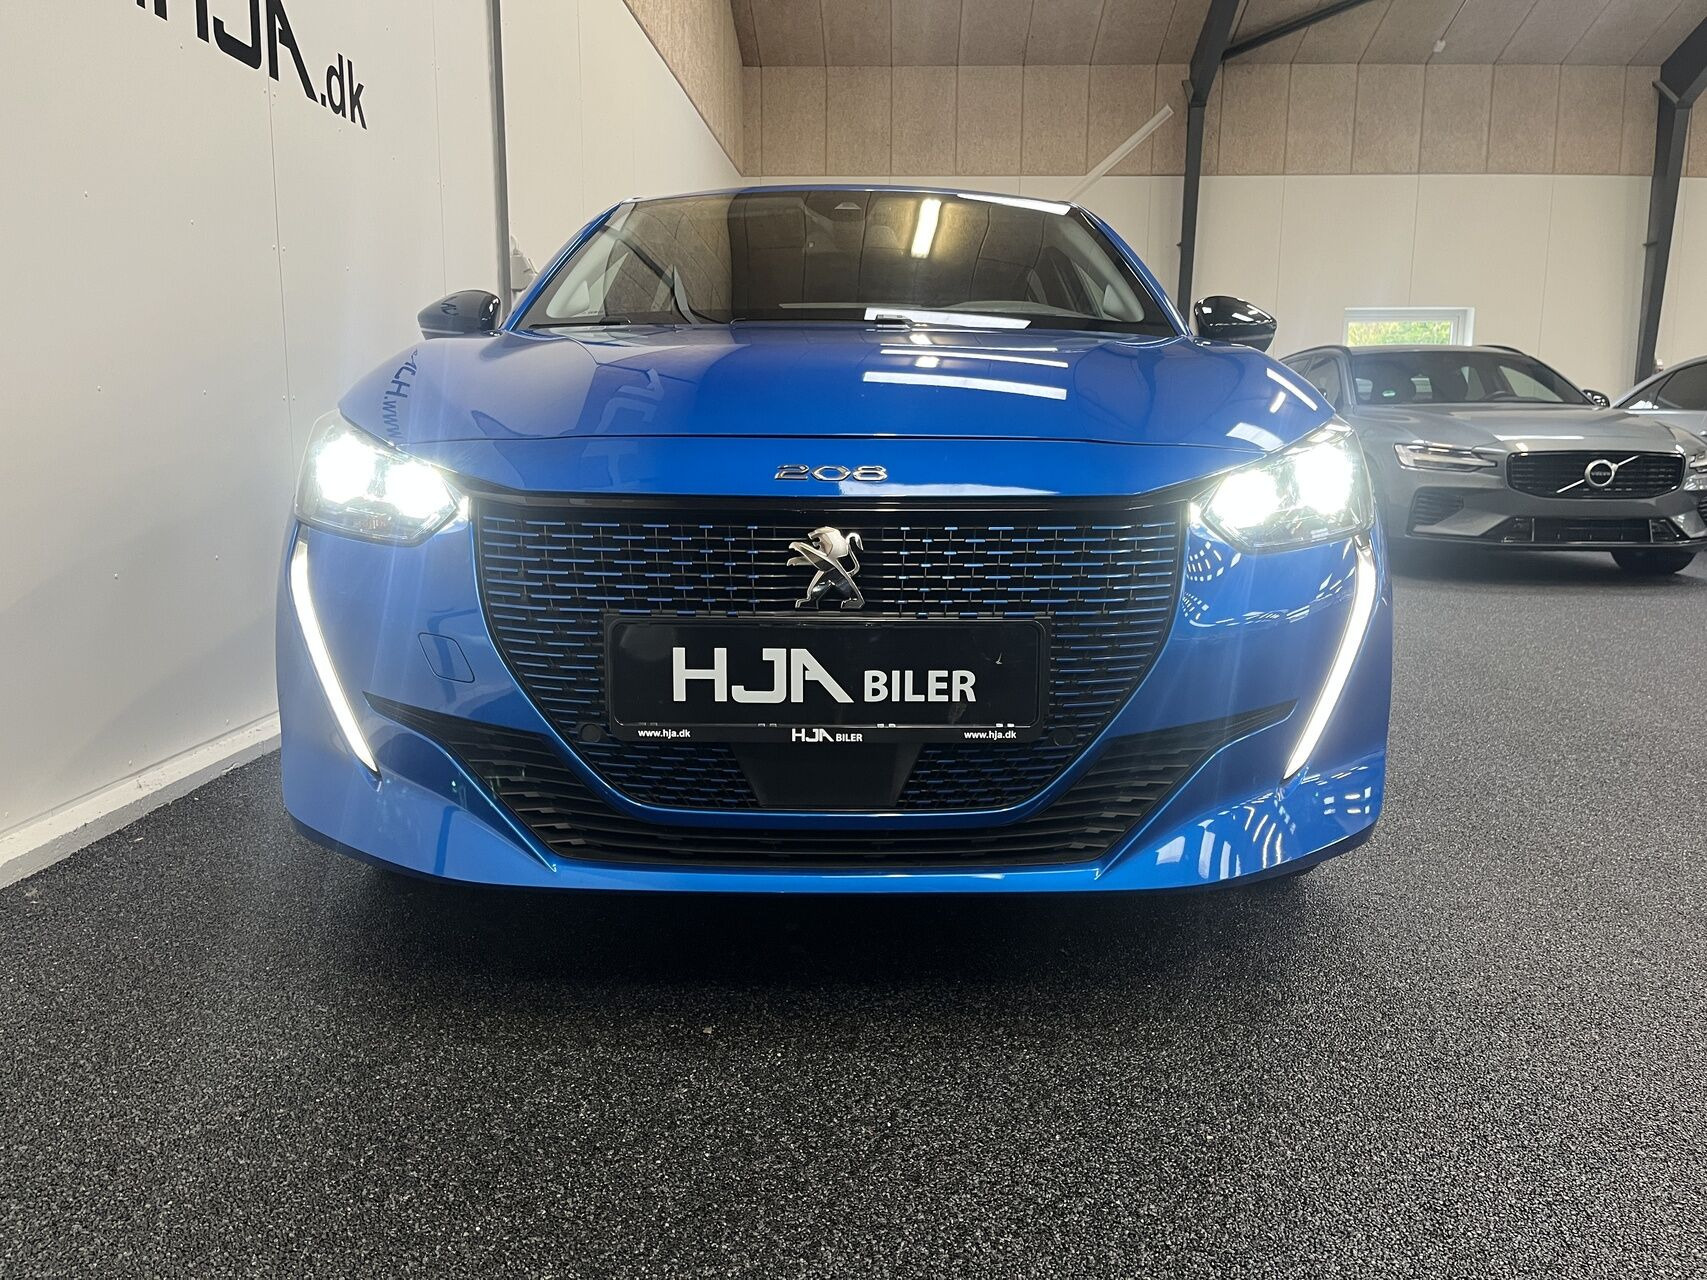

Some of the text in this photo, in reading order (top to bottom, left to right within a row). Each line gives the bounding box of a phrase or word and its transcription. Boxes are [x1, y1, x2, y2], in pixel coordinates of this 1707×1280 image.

[774, 464, 888, 482] 208
[672, 646, 977, 704] HJA BILER
[637, 728, 691, 740] www.hja.dk
[791, 727, 863, 743] HJA BILER
[963, 730, 1017, 741] www.hja.dk
